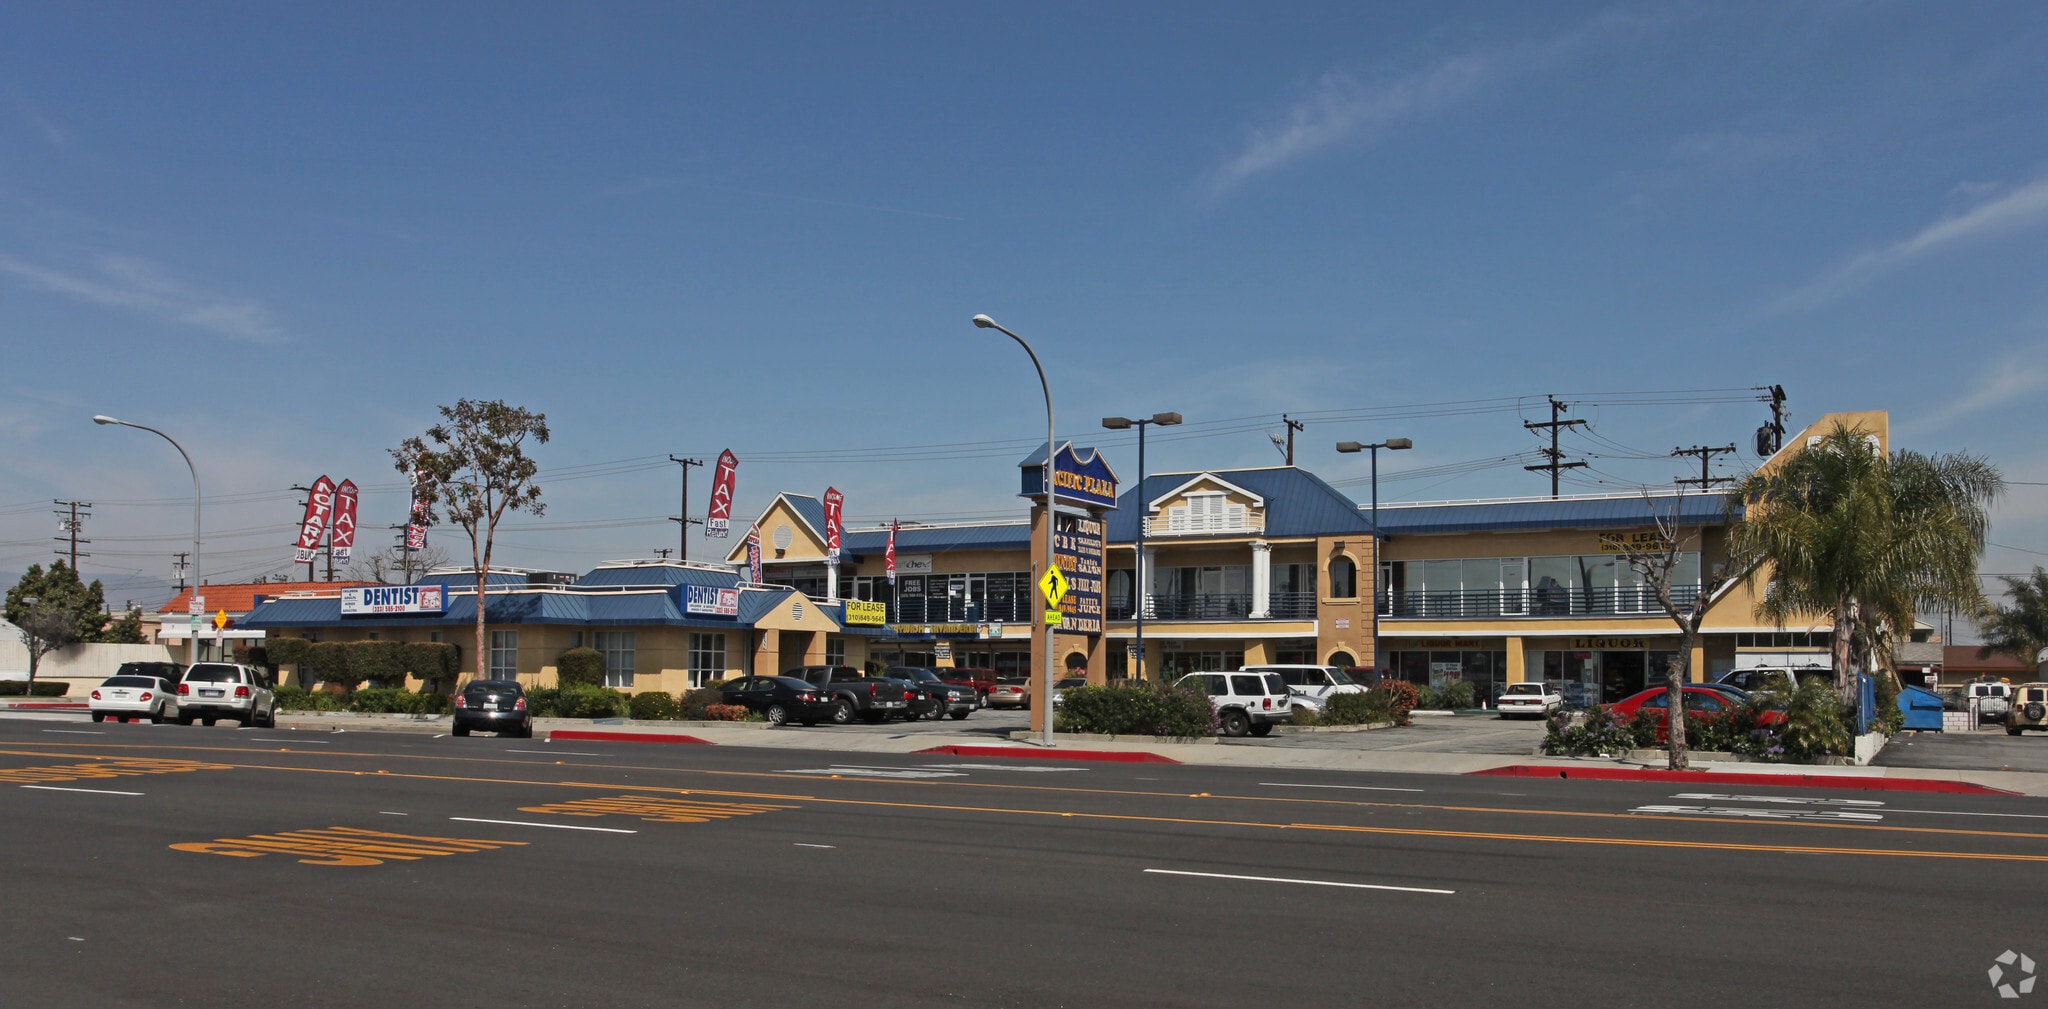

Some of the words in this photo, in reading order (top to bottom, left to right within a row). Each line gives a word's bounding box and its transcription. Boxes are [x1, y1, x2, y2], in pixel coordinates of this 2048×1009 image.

[712, 465, 735, 518] TAX
[1045, 469, 1083, 491] ACIFIC
[1083, 476, 1115, 498] PLAZA
[302, 482, 332, 547] NOTARY
[334, 494, 356, 546] TAX
[710, 519, 727, 528] Fast
[827, 502, 840, 548] TAX
[1077, 518, 1101, 535] LIQUOR
[707, 528, 729, 538] Refund
[1599, 533, 1624, 543] FOR
[1053, 553, 1077, 573] ENTIST
[1078, 563, 1102, 575] SALON
[364, 587, 419, 605] DENTIST
[688, 586, 718, 605] DENTIST
[846, 601, 861, 611] FOR
[862, 602, 885, 613] LEASE
[1077, 604, 1101, 615] JUICE
[1575, 638, 1645, 649] LIQUOR
